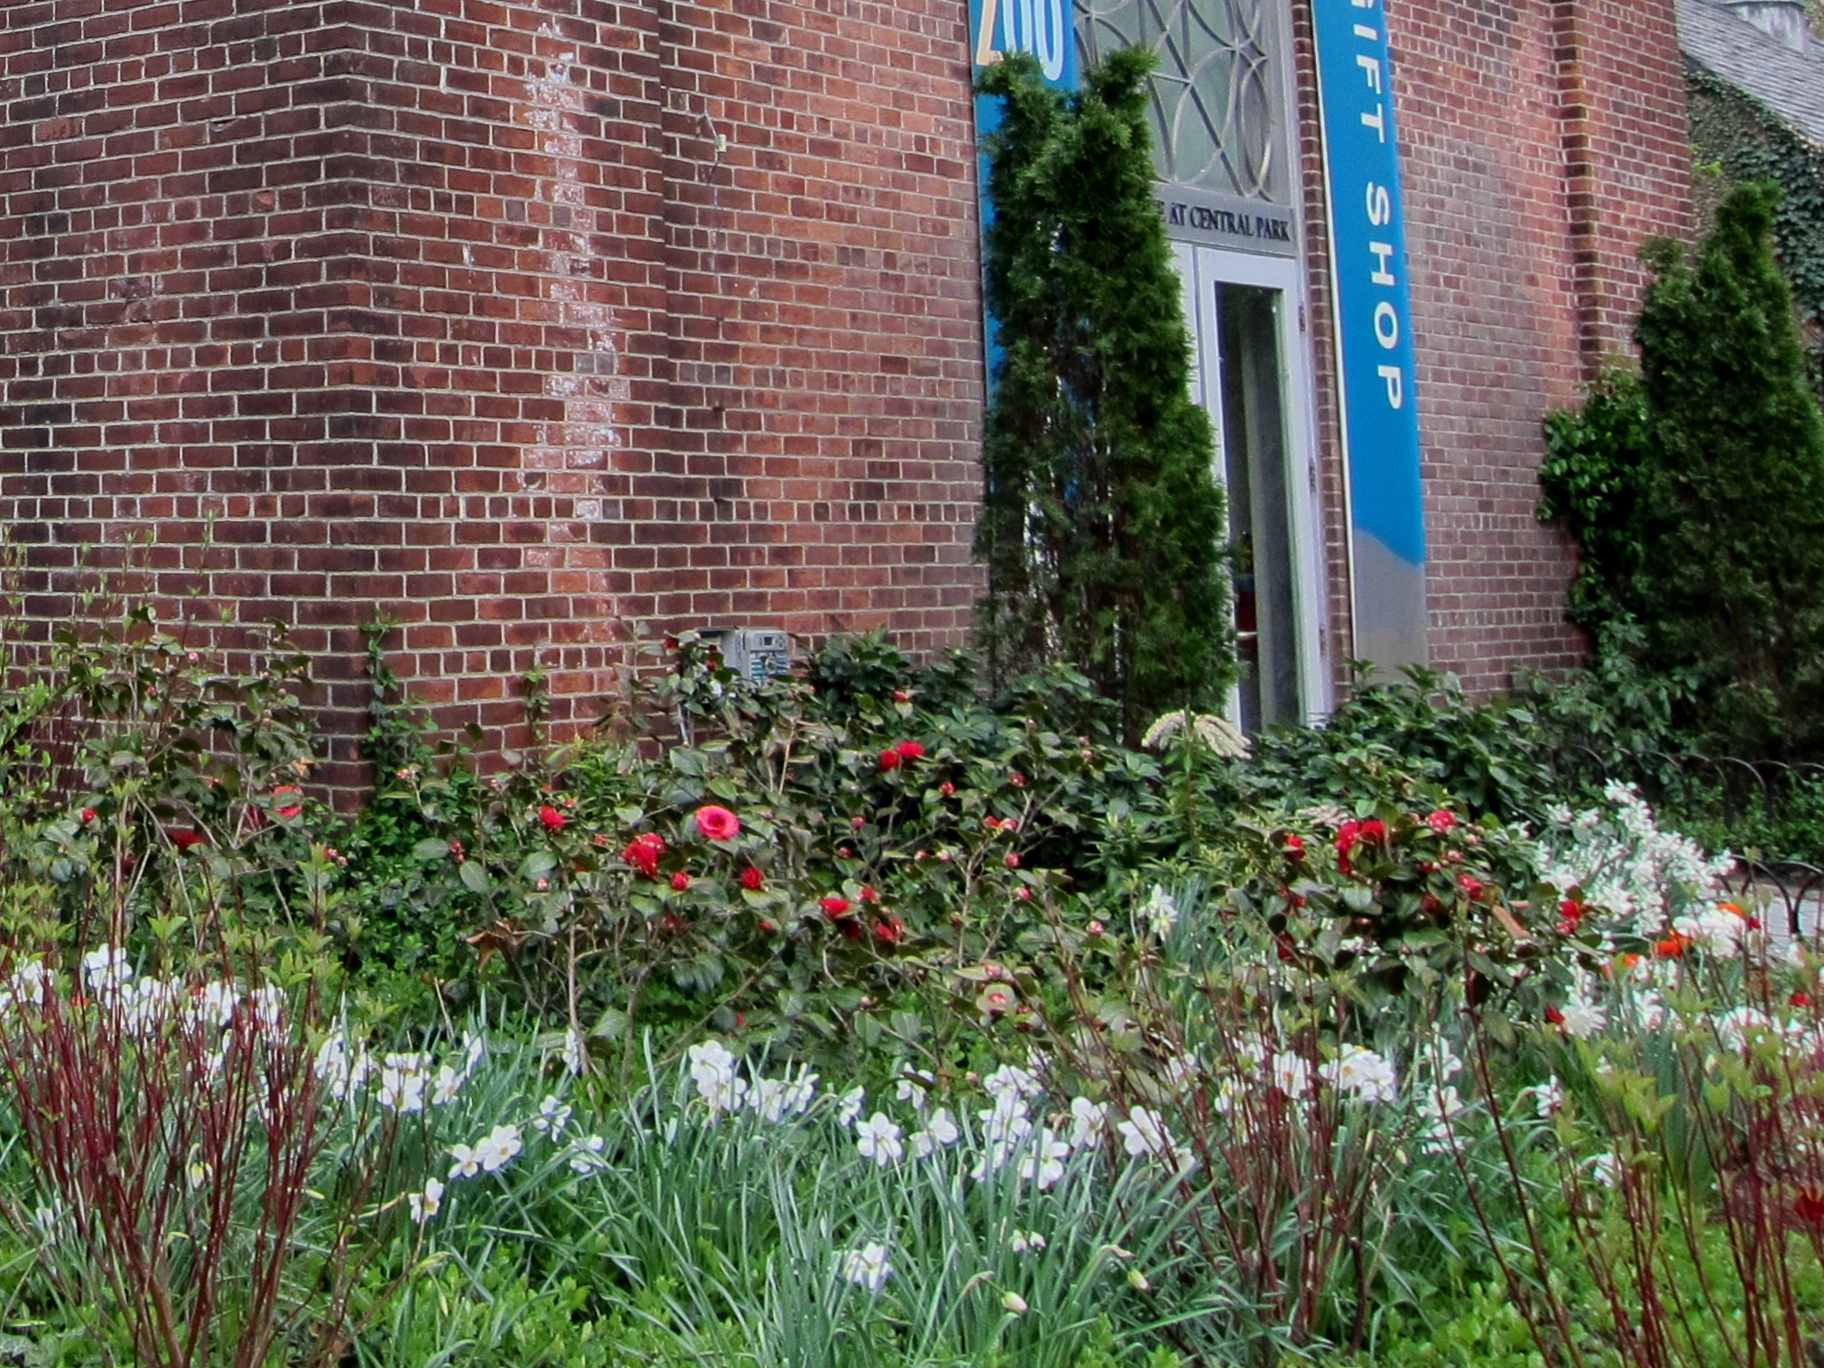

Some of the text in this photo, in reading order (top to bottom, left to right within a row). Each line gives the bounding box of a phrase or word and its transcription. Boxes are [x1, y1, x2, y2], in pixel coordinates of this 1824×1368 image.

[1169, 202, 1187, 226] AT
[1190, 206, 1254, 237] CENTRAL
[1255, 216, 1291, 242] PARK
[1366, 181, 1403, 410] SHOP
